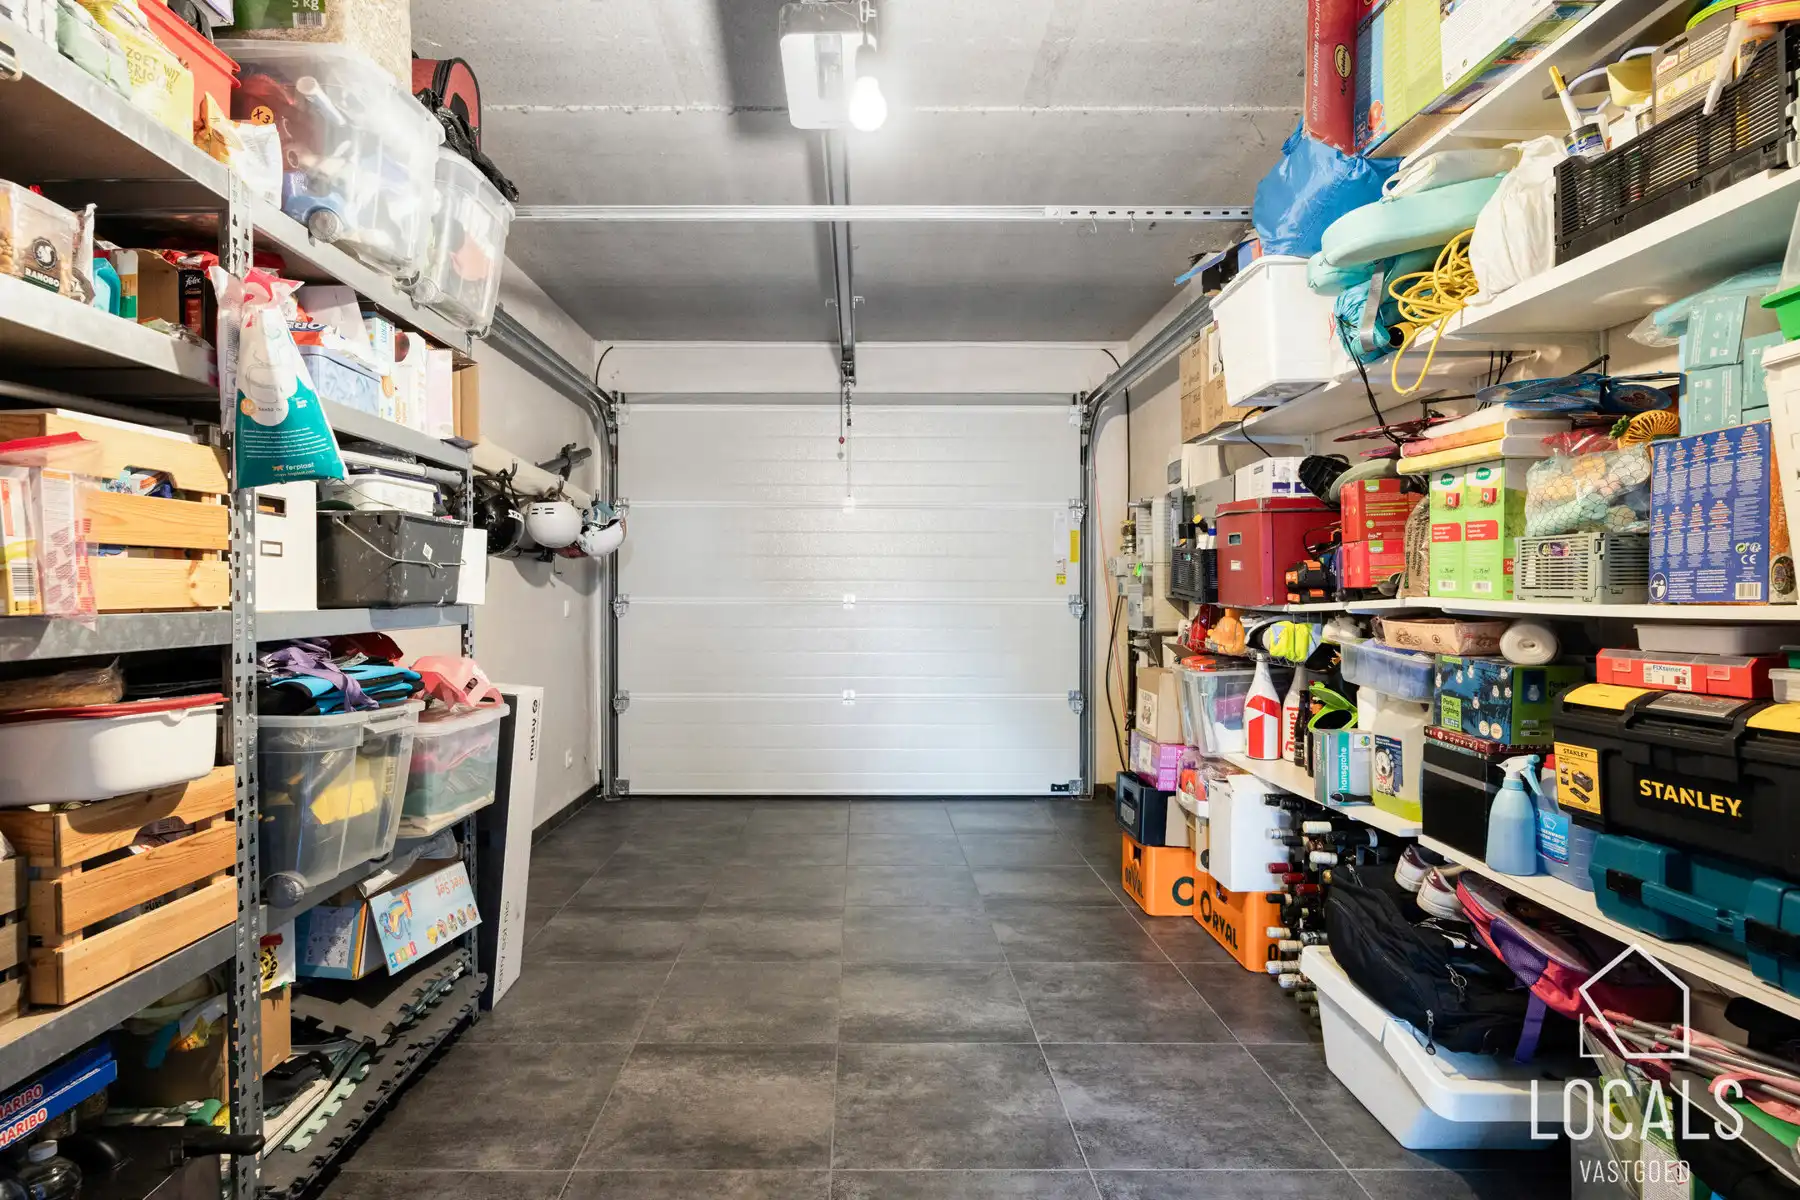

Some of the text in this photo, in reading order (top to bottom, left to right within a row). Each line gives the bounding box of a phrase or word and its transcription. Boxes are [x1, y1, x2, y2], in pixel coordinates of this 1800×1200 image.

[286, 462, 314, 471] ferplast
[1338, 747, 1349, 790] hansgrohe
[1563, 748, 1588, 758] STANLEY
[1640, 779, 1742, 817] STANLEY
[1125, 867, 1144, 899] ORVAL
[1201, 890, 1239, 950] ORVAL
